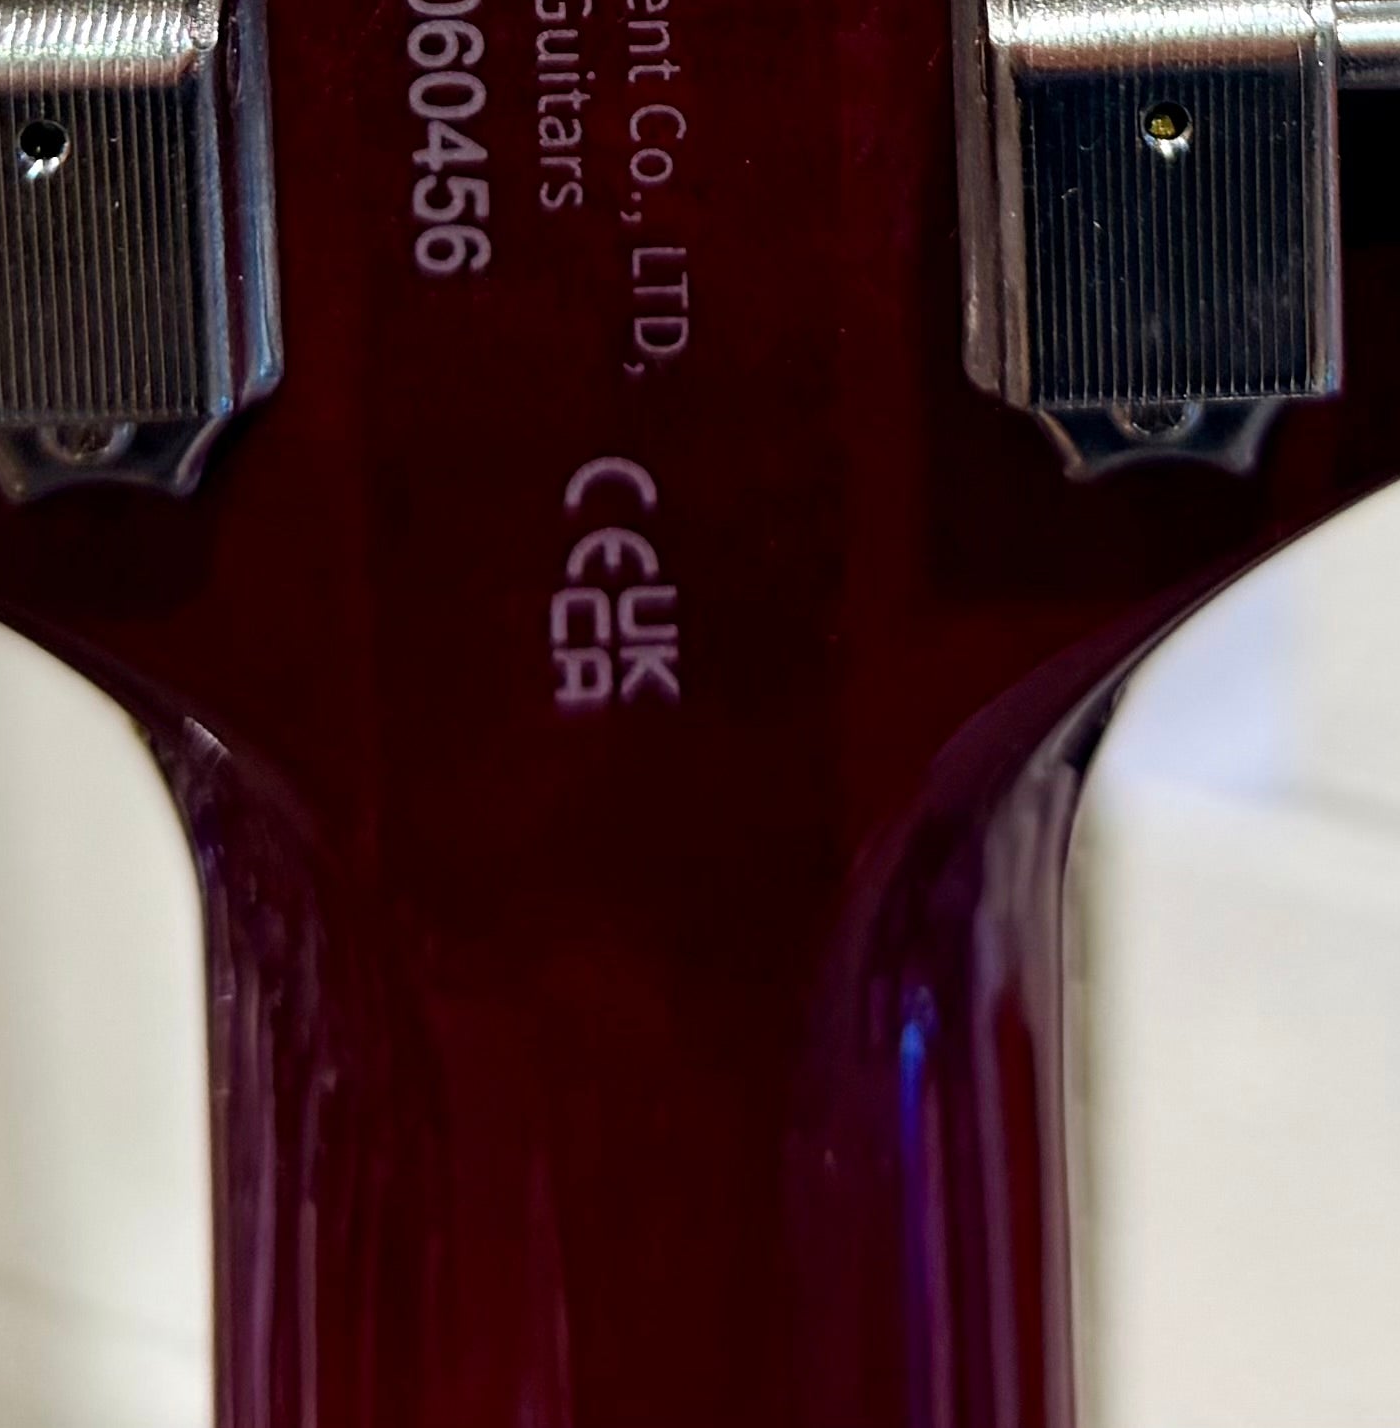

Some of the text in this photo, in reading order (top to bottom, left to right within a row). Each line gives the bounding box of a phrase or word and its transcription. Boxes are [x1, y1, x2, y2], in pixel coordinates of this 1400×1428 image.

[621, 104, 687, 223] Co.,
[623, 246, 689, 376] LTD,
[563, 457, 659, 580] CE
[551, 588, 612, 707] CA
[617, 584, 679, 700] UK
